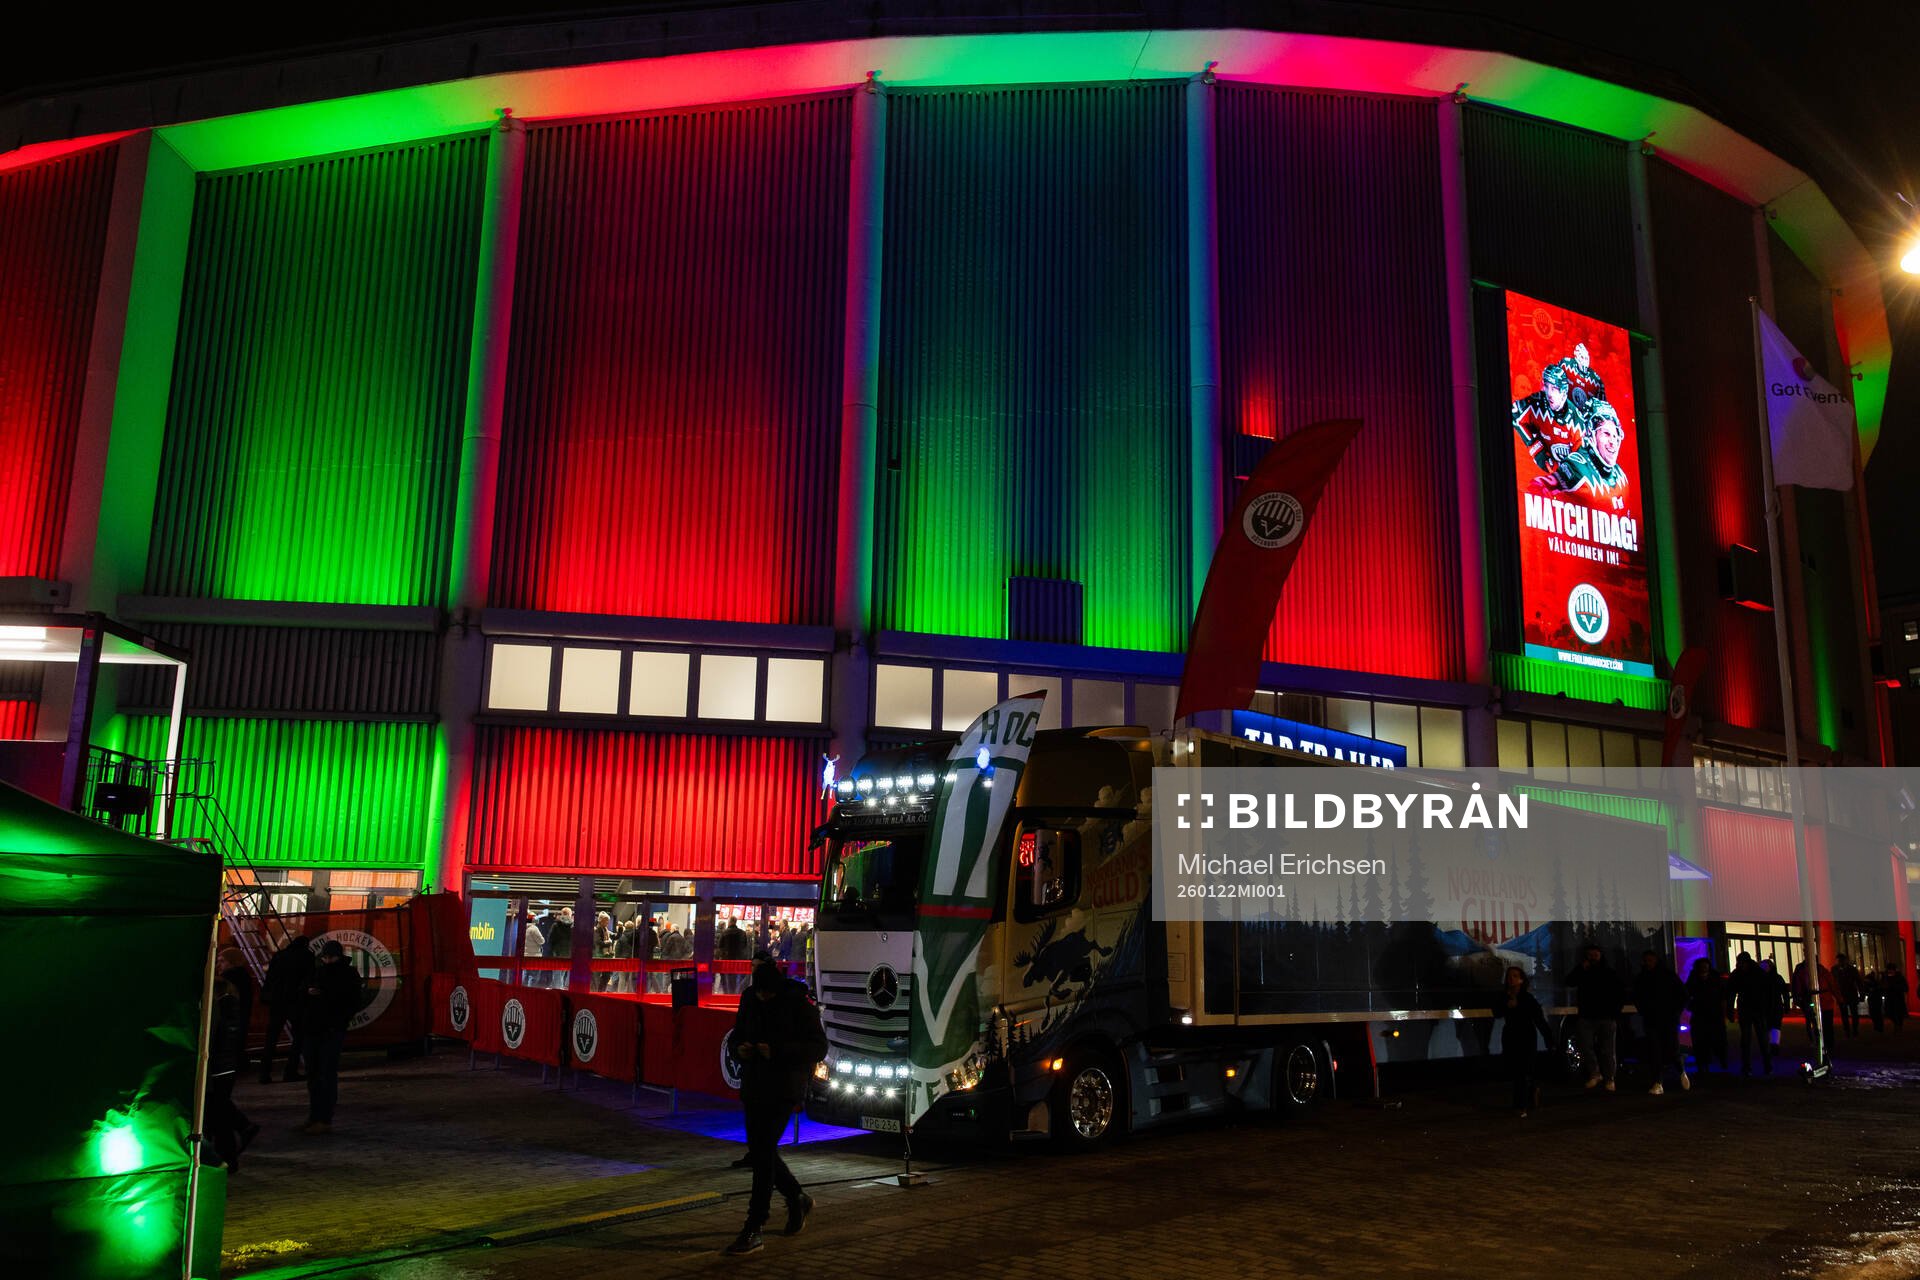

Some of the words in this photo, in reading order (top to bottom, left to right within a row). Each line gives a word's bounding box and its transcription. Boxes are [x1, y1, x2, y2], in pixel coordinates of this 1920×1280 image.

[1524, 493, 1590, 540] MATCH
[1592, 508, 1638, 552] IDAG!
[1548, 536, 1604, 563] VÄLKOMMEN
[1606, 550, 1620, 566] IN!
[1447, 865, 1537, 909] NORRLANDS
[1461, 897, 1530, 945] GULD
[336, 932, 374, 948] HOCKEY
[373, 945, 391, 968] CLUB
